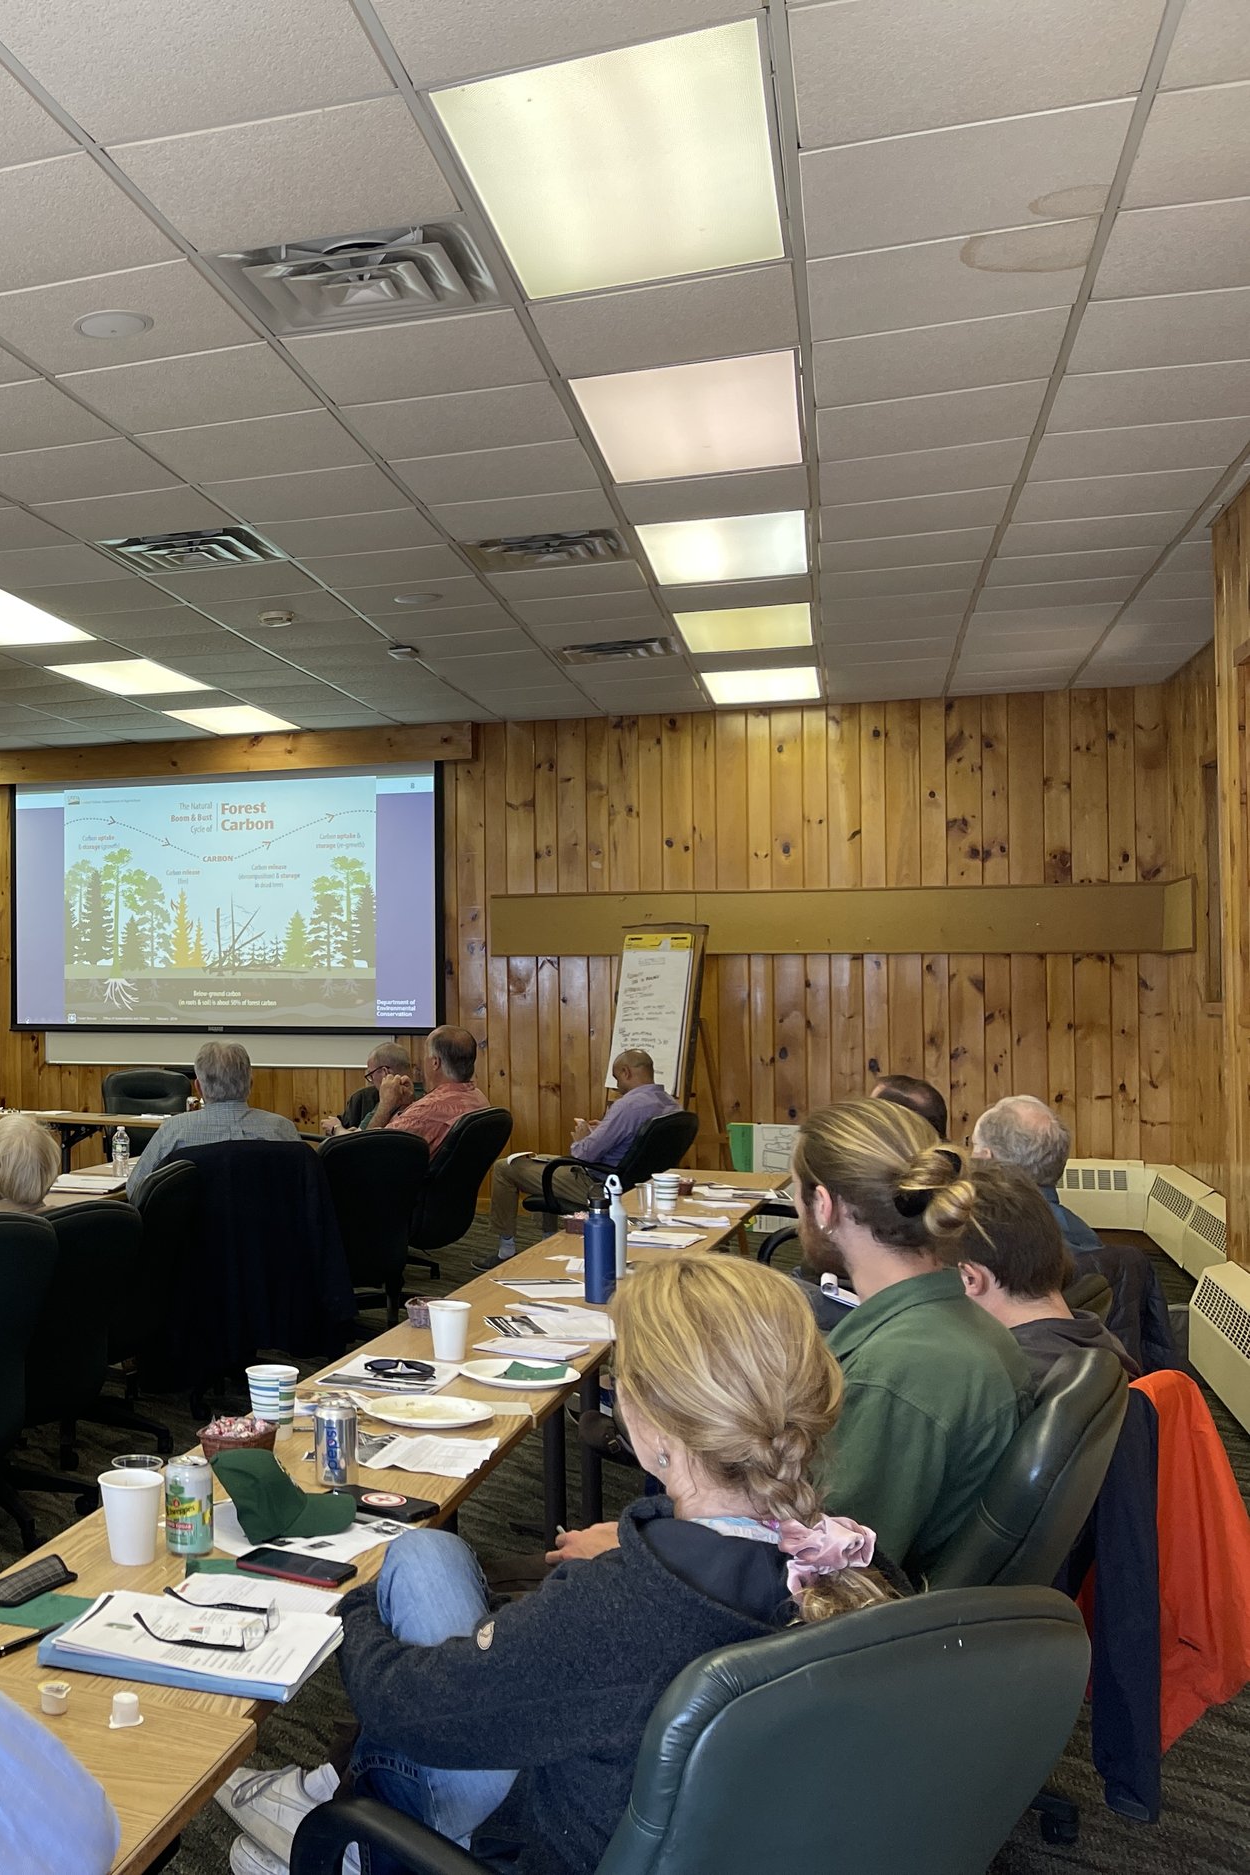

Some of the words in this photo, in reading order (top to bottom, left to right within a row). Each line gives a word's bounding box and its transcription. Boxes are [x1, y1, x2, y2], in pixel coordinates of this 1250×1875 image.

[191, 802, 213, 810] Natural
[221, 801, 267, 815] Forest
[197, 813, 213, 821] Bust
[221, 818, 275, 831] Carbon
[190, 826, 205, 835] Cycle
[205, 825, 213, 833] of
[98, 834, 115, 842] uptake
[337, 832, 356, 840] uptake
[202, 855, 234, 863] CARBON
[193, 990, 225, 998] Below-ground
[324, 1426, 342, 1471] pepsi
